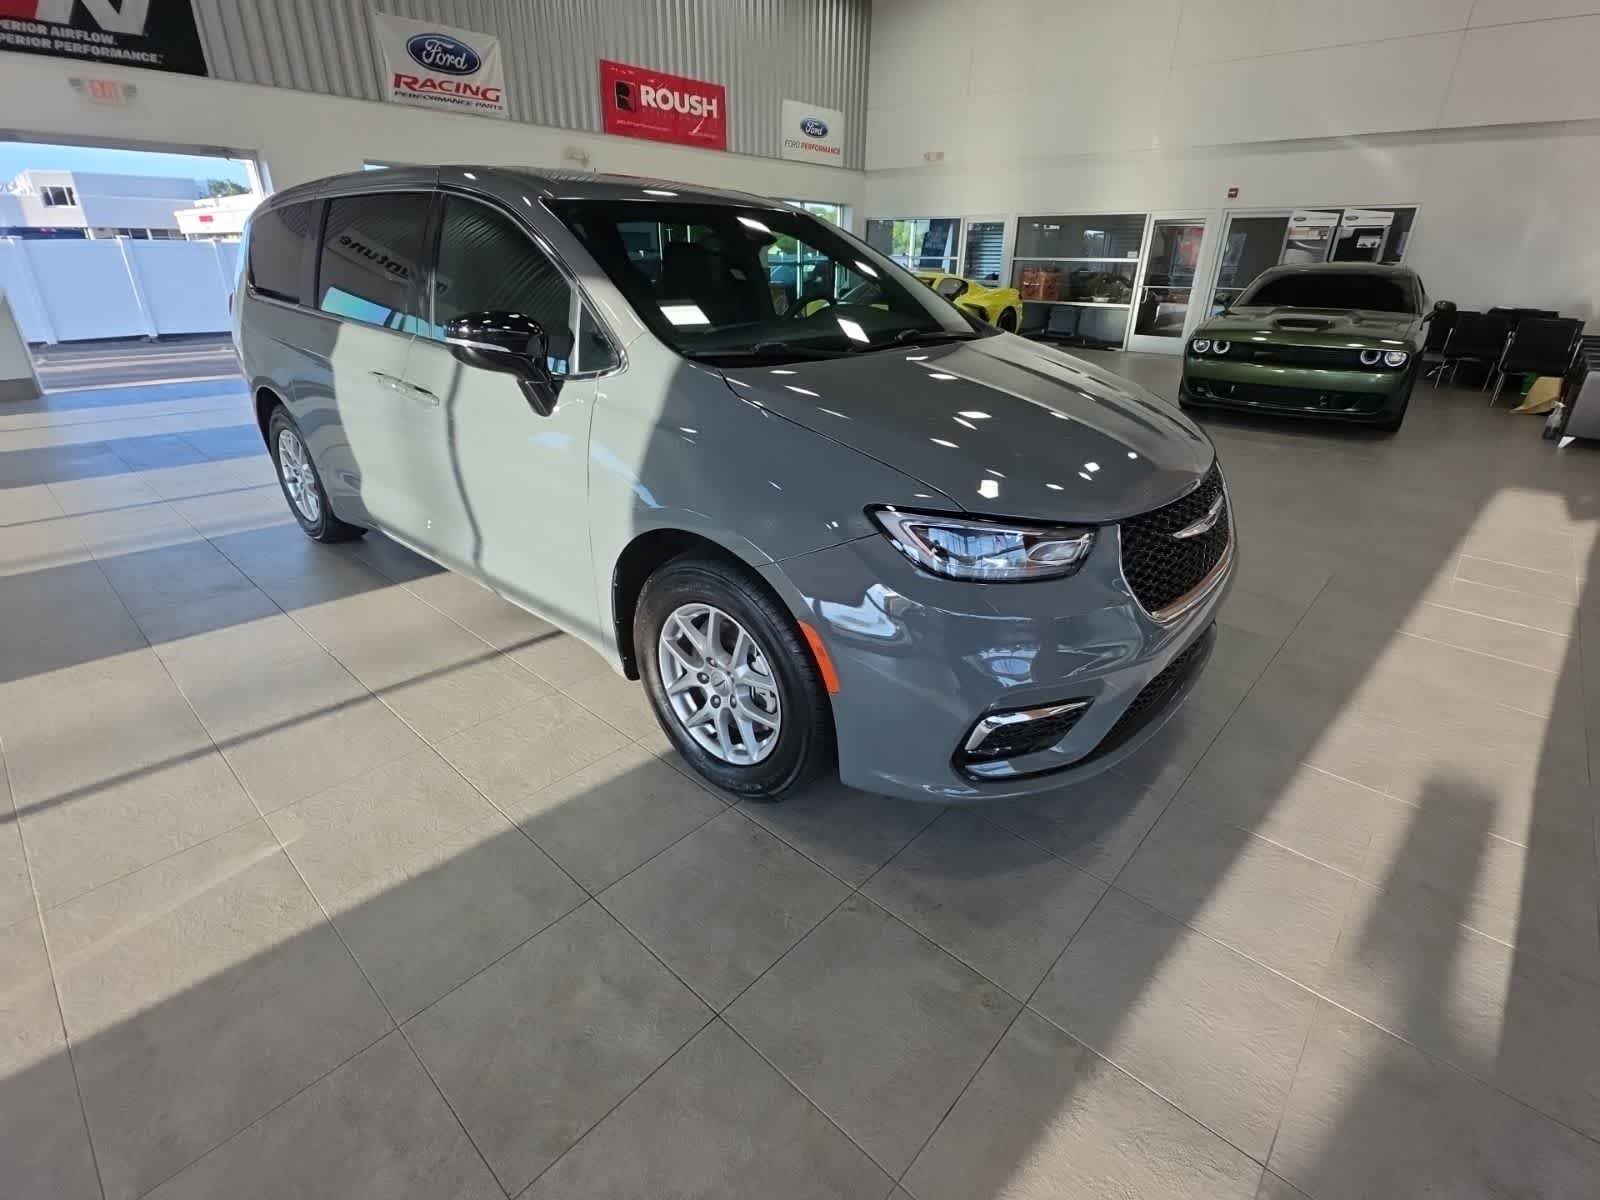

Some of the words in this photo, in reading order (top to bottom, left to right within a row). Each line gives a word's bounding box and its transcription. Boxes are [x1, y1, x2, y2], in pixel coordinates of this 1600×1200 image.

[50, 26, 118, 45] AIRFLOW.
[421, 39, 468, 70] Ford
[393, 73, 501, 102] RACING
[394, 90, 473, 106] PERFORMANCE
[475, 102, 504, 111] PARTS
[640, 84, 718, 119] ROUSH
[784, 139, 801, 149] FORD
[801, 142, 841, 156] PERFORMANCE
